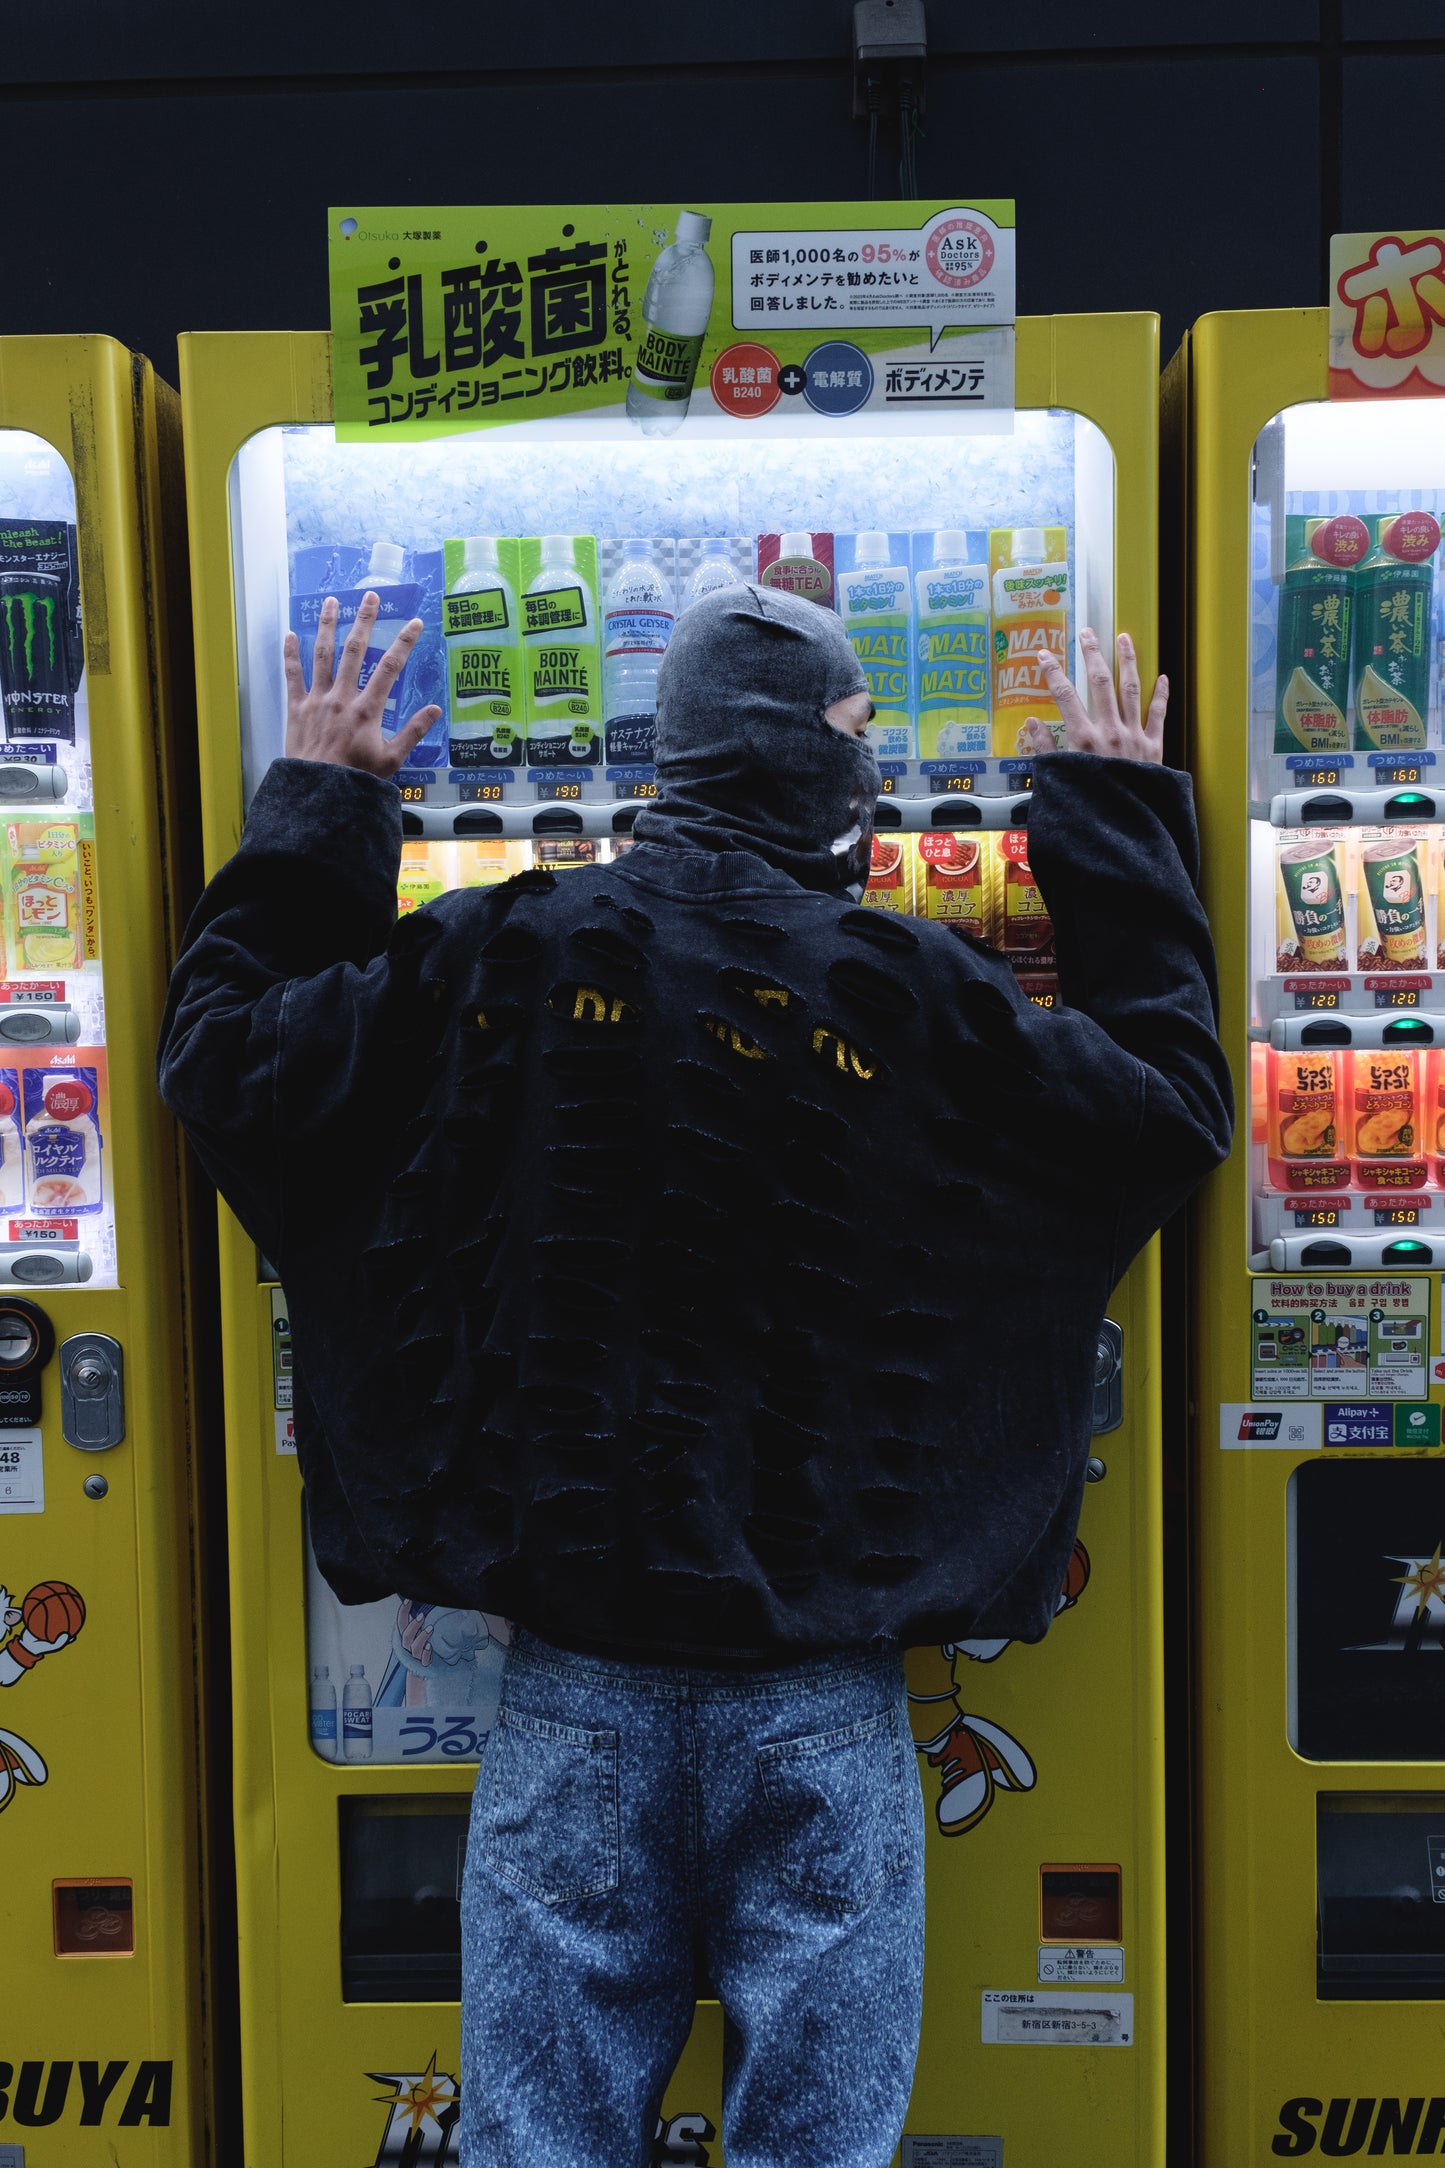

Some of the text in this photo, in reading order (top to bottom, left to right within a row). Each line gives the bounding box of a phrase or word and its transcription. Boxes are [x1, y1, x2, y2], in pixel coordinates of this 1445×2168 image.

[358, 230, 442, 242] Otsuka 大塚製薬
[941, 237, 978, 250] Ask
[750, 244, 920, 266] 医師1,000名の95%が
[940, 251, 980, 259] Doctors
[750, 271, 920, 287] ボディメンテを勧めたいと
[611, 239, 633, 342] がとれる、
[750, 295, 847, 311] 回答しました。
[357, 240, 608, 391] 乳酸菌
[646, 333, 689, 359] BODY
[722, 366, 773, 385] 乳酸菌
[812, 370, 864, 387] 電解質
[885, 367, 985, 393] ボディメンテ
[368, 347, 633, 427] コンディショニング飲料。
[733, 386, 762, 399] B240
[3, 531, 62, 548] the Beast!
[1402, 535, 1429, 548] 渋み
[1335, 540, 1358, 553] 渋み
[1324, 574, 1348, 583] 伊藤園
[1393, 570, 1420, 578] 伊藤園
[1004, 573, 1068, 593] 後味スッキリ!
[1010, 591, 1041, 602] ビタミン
[447, 600, 479, 614] 毎日の
[525, 598, 557, 613] 毎日の
[1018, 600, 1044, 609] みかん
[449, 610, 503, 629] 体調管理に
[526, 608, 581, 628] 体調管理に
[608, 618, 670, 631] CRYSTAL GEYSER
[1380, 590, 1414, 654] 濃い茶
[1311, 594, 1342, 658] 濃い茶
[462, 653, 501, 669] BODY
[540, 652, 580, 668] BODY
[10, 706, 62, 714] ENERGY
[1300, 713, 1337, 728] 体脂肪
[1367, 709, 1408, 725] 体脂肪
[883, 728, 909, 736] ゴクゴク
[961, 726, 986, 734] ゴクゴク
[1311, 772, 1336, 784] 160
[1392, 769, 1418, 782] 160
[476, 786, 501, 799] 190
[555, 784, 579, 798] 190
[633, 784, 657, 797] 130
[38, 840, 76, 849] ビタミンC
[923, 834, 952, 846] ほっと
[925, 848, 951, 858] ひと息
[22, 896, 58, 907] ほっと
[865, 891, 893, 902] 濃厚
[942, 891, 970, 902] 濃厚
[22, 908, 61, 921] レモン
[936, 902, 977, 916] ココア
[1289, 981, 1346, 990] あったか〜い
[1369, 979, 1428, 988] あったか〜い
[16, 993, 53, 1001] ¥150
[1311, 994, 1336, 1007] 120
[1392, 992, 1416, 1005] 120
[50, 1054, 76, 1066] Asahi
[1297, 1065, 1332, 1080] じっくり
[1371, 1064, 1410, 1079] じっくり
[1297, 1079, 1333, 1091] コトコト
[1371, 1078, 1410, 1090] コトコト
[50, 1092, 79, 1112] 濃厚
[33, 1144, 78, 1155] ロイヤル
[34, 1156, 82, 1168] ルクティー
[1304, 1176, 1337, 1185] 食べ応え
[1377, 1176, 1412, 1185] 食べ応え
[1289, 1199, 1347, 1208] あったか〜い
[1369, 1198, 1426, 1207] あったか〜い
[1311, 1212, 1336, 1224] 150
[1391, 1210, 1416, 1223] 150
[25, 1230, 57, 1239] ¥150
[1270, 1280, 1411, 1298] How to buy a drink
[1271, 1299, 1338, 1309] 饮料的购买方法
[1371, 1298, 1387, 1308] 구입
[1392, 1298, 1409, 1308] 방법
[1257, 1311, 1265, 1320] 1
[1314, 1311, 1322, 1320] 2
[1372, 1311, 1381, 1320] 3
[1242, 1419, 1280, 1430] UnionPay
[1256, 1426, 1275, 1436] 银联
[1348, 1425, 1389, 1440] 支付宝
[984, 1993, 1035, 2003] ここの住所は
[1021, 2019, 1097, 2031] 新宿区新宿3-5-3
